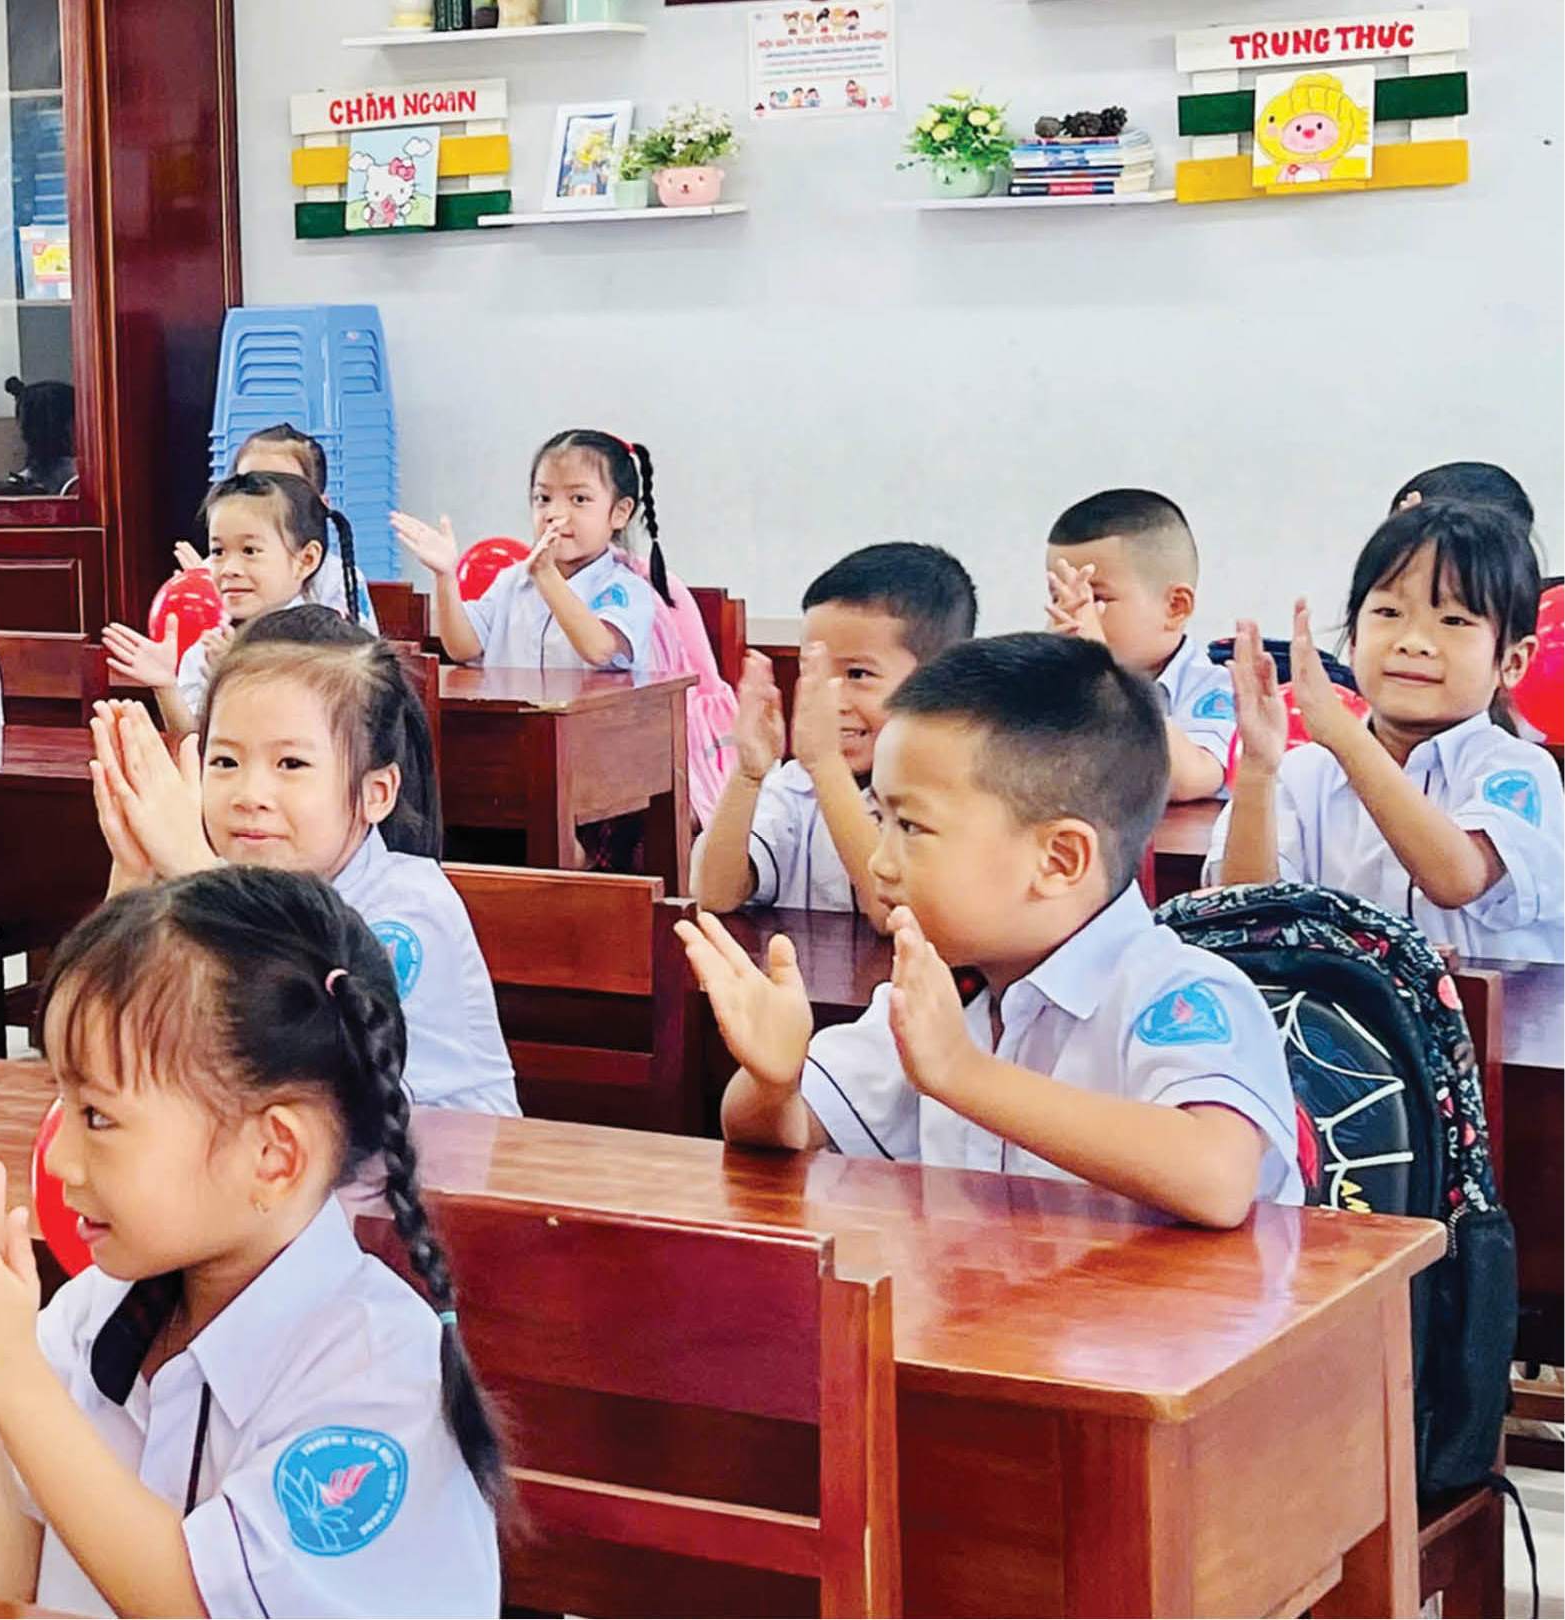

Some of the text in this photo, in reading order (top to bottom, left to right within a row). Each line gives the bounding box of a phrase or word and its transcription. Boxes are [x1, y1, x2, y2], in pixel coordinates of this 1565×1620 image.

[1229, 21, 1414, 60] TRUNG THỰC
[329, 89, 476, 125] CHĂM NGOAN
